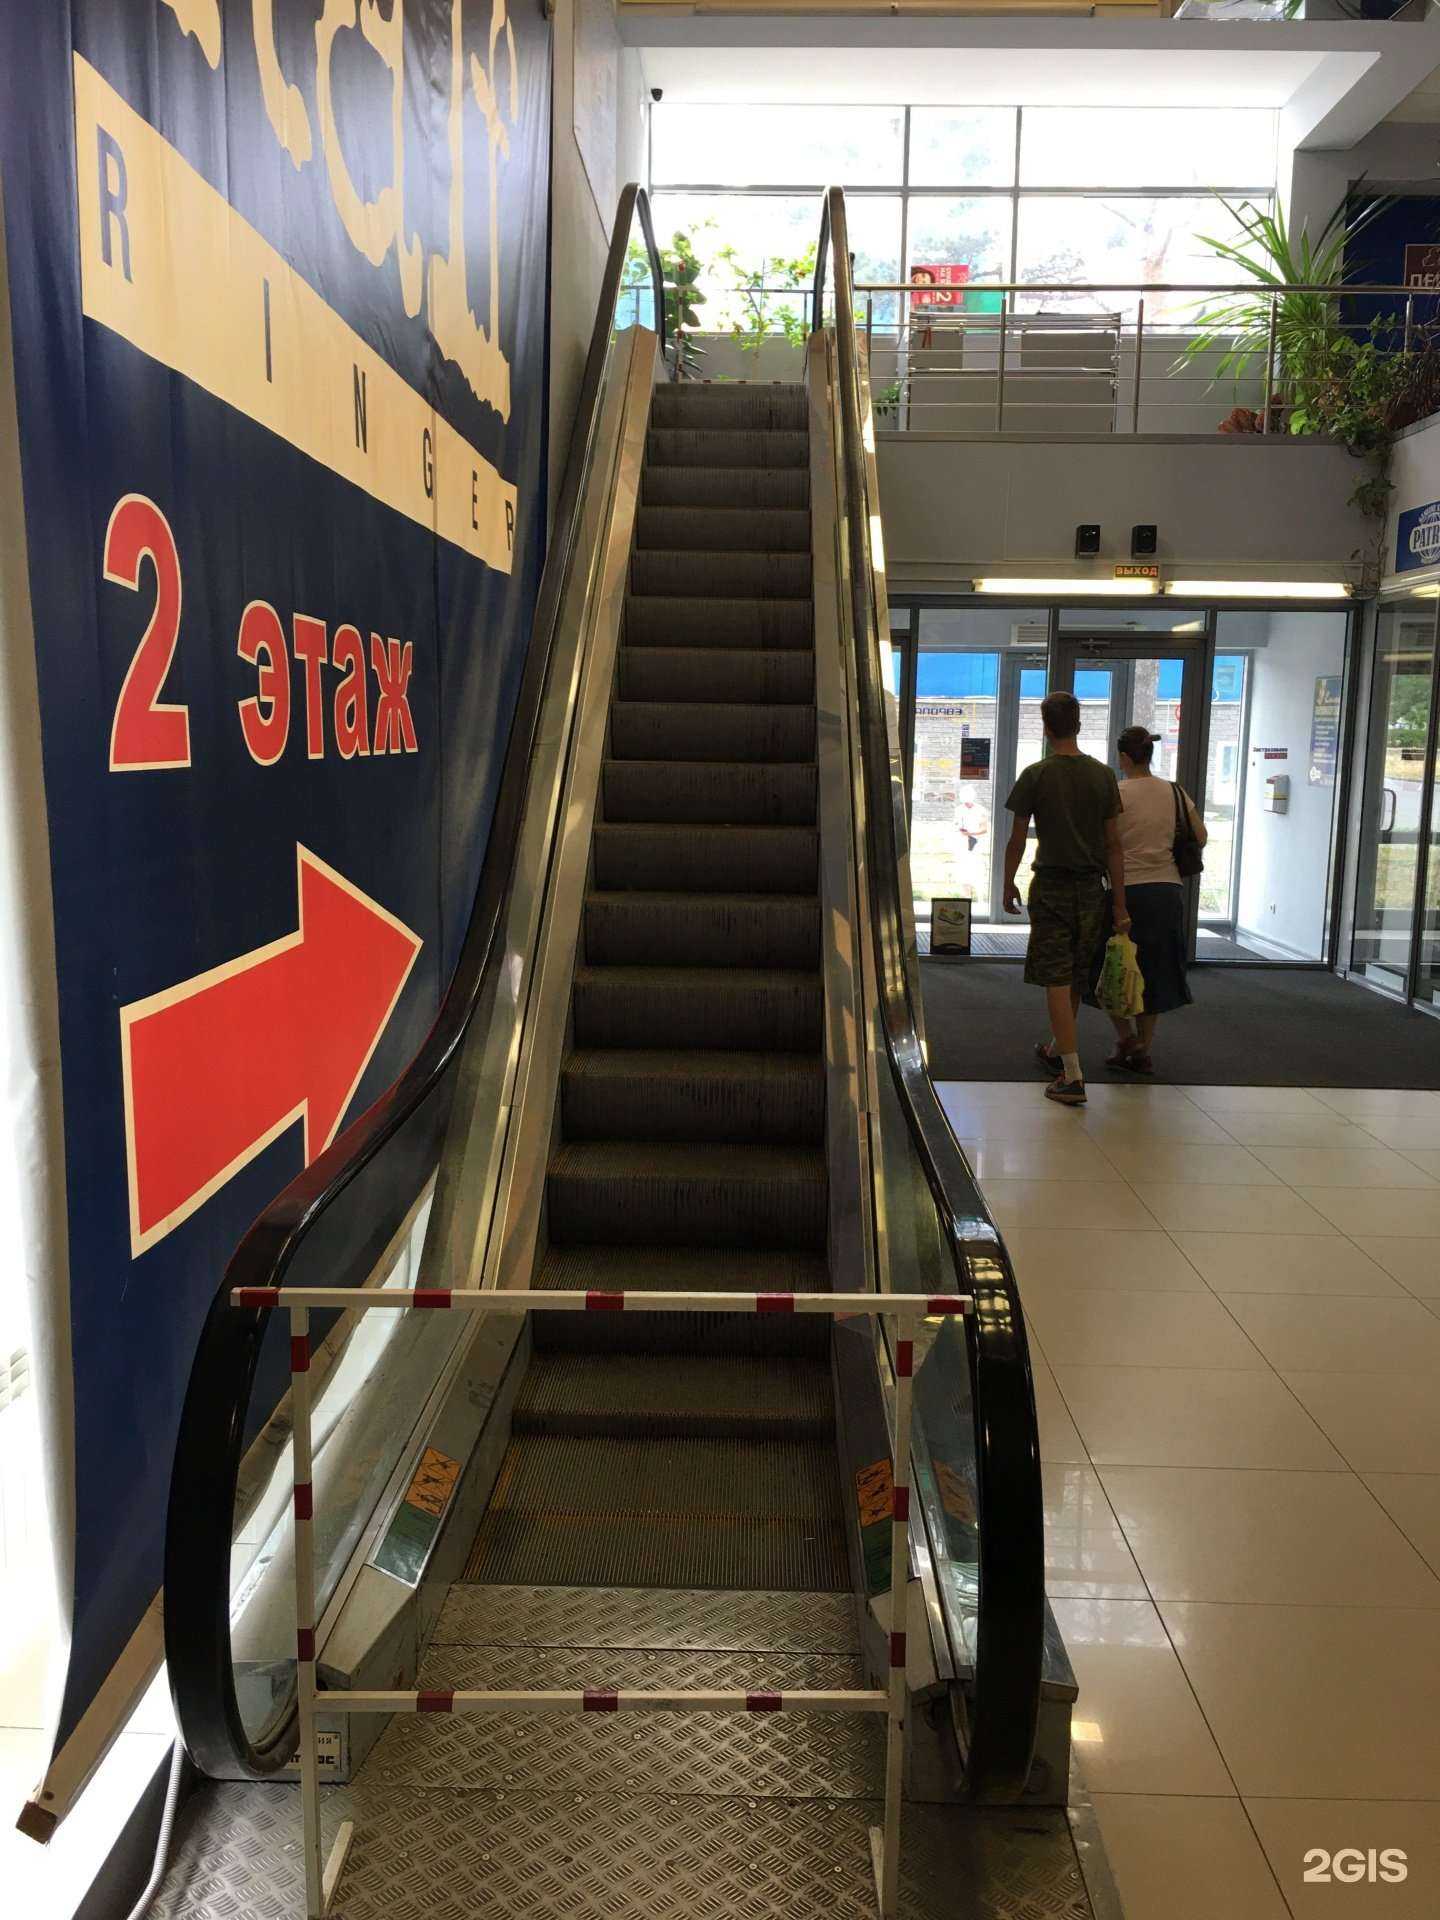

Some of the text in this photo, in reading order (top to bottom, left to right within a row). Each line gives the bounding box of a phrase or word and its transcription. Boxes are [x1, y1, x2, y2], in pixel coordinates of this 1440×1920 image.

[97, 123, 515, 552] RINGER
[103, 493, 418, 772] 2 этаж
[1116, 566, 1157, 576] ВЫХОД
